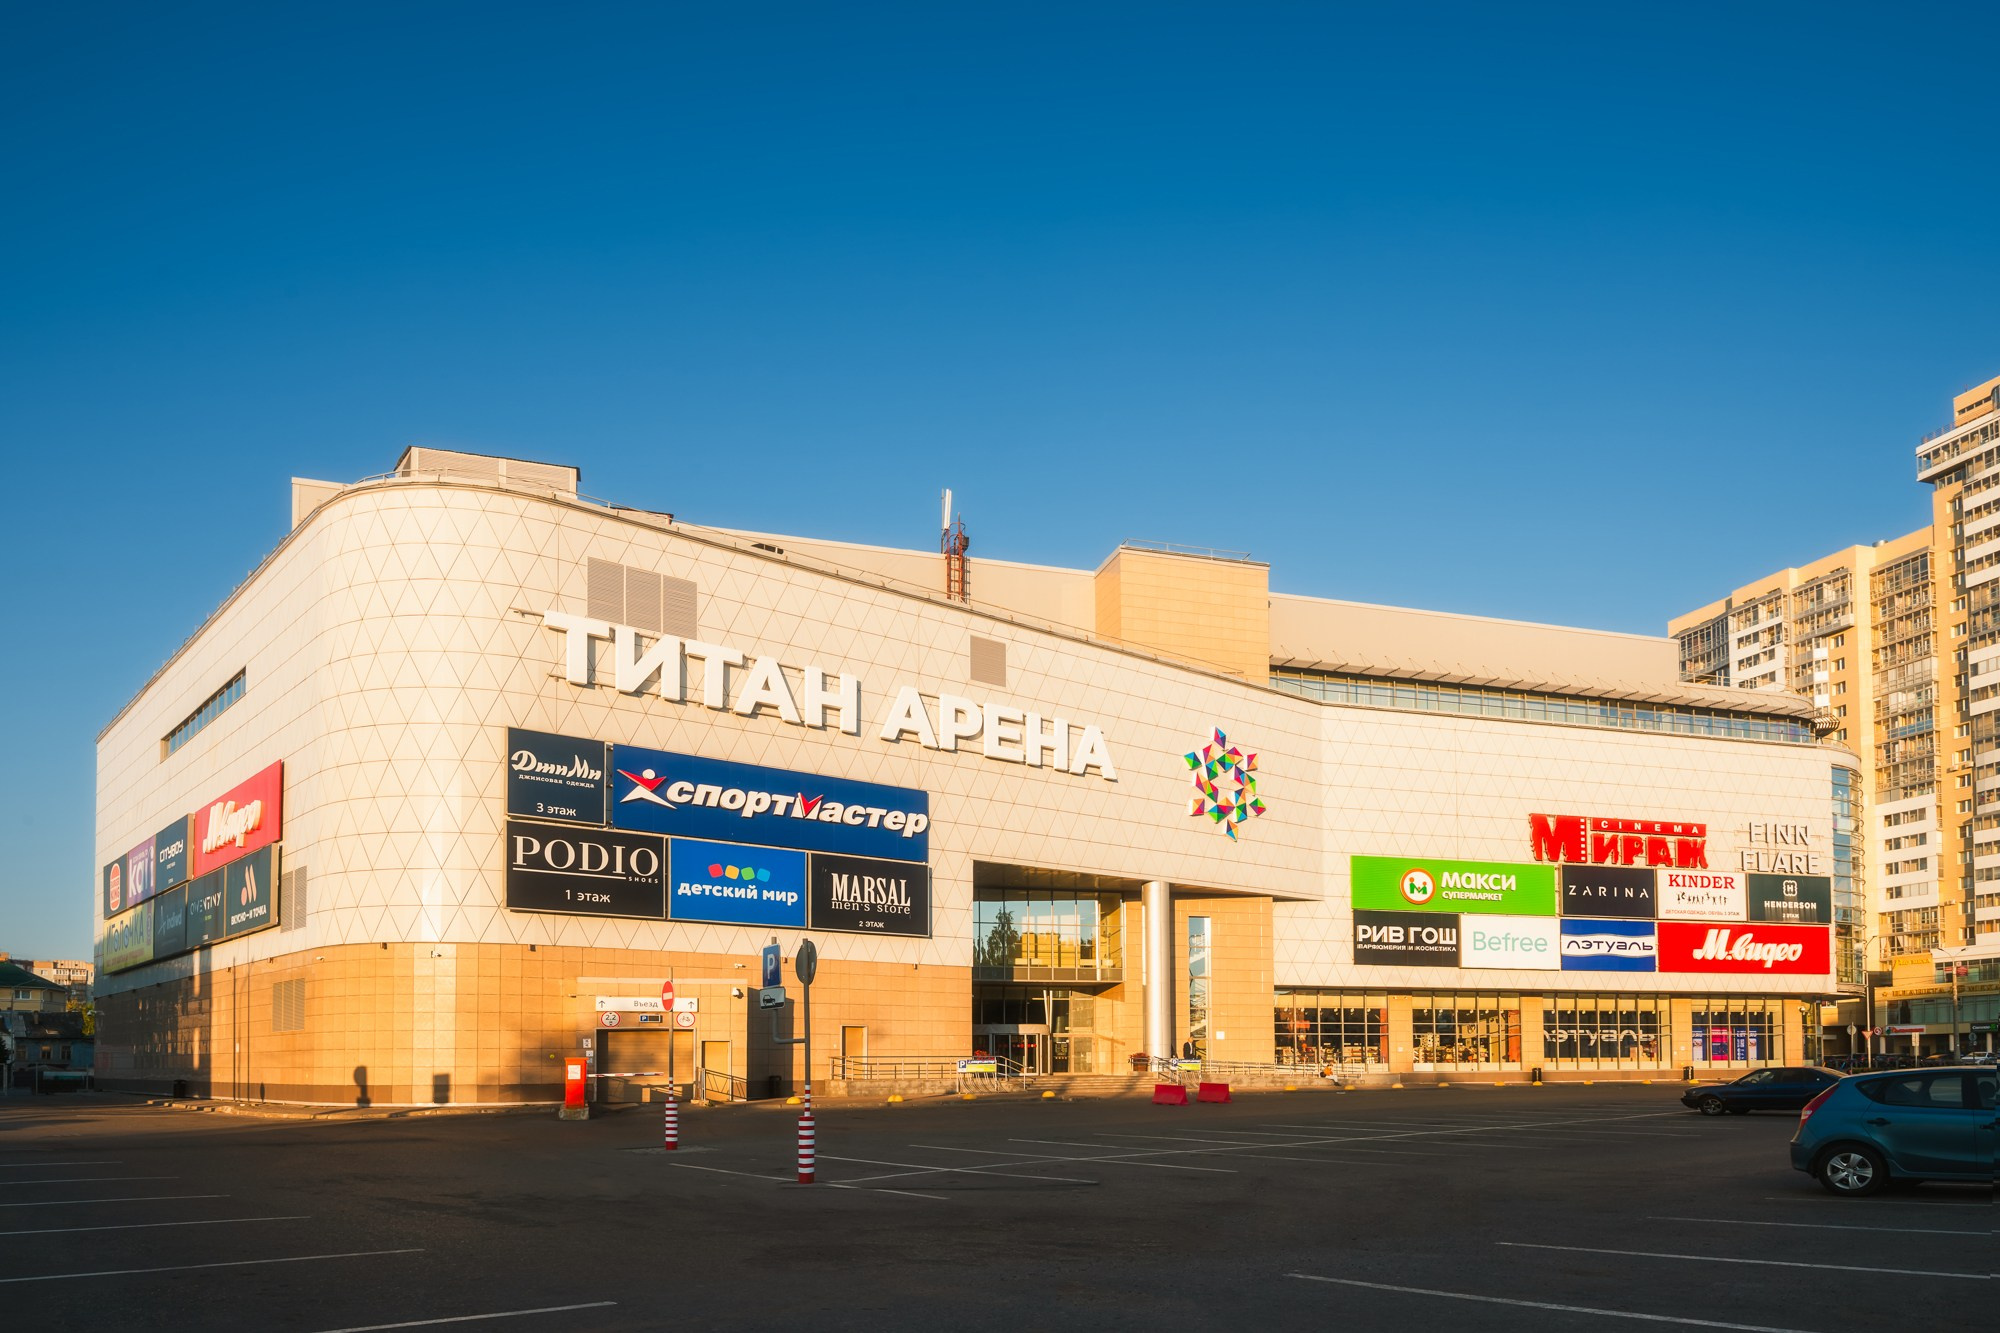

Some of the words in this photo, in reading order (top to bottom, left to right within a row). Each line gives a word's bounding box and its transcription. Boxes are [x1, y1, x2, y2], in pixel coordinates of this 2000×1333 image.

[543, 610, 861, 734] ТИТАН
[879, 686, 1118, 781] АРЕНА
[566, 780, 595, 788] одежда
[536, 802, 544, 813] 3
[547, 806, 576, 816] этаж
[1601, 820, 1699, 834] CINEMA
[1749, 822, 1809, 846] FINN
[1528, 813, 1708, 869] МИРАЖ
[512, 835, 659, 877] PODIO
[1741, 851, 1819, 875] FLARE
[628, 876, 659, 884] SHOES
[1668, 874, 1736, 889] KINDER
[565, 890, 571, 900] 1
[577, 892, 611, 903] этаж
[677, 881, 758, 900] детский
[762, 888, 799, 906] мир
[831, 873, 911, 906] MARSAL
[1568, 885, 1649, 898] ZARINA
[831, 901, 870, 911] men's
[876, 904, 911, 914] store
[1764, 901, 1817, 909] HENDERSON
[1357, 925, 1404, 943] РИВ
[1408, 927, 1457, 945] ГОШ
[1472, 931, 1548, 953] Befree
[633, 1000, 659, 1008] Въезд
